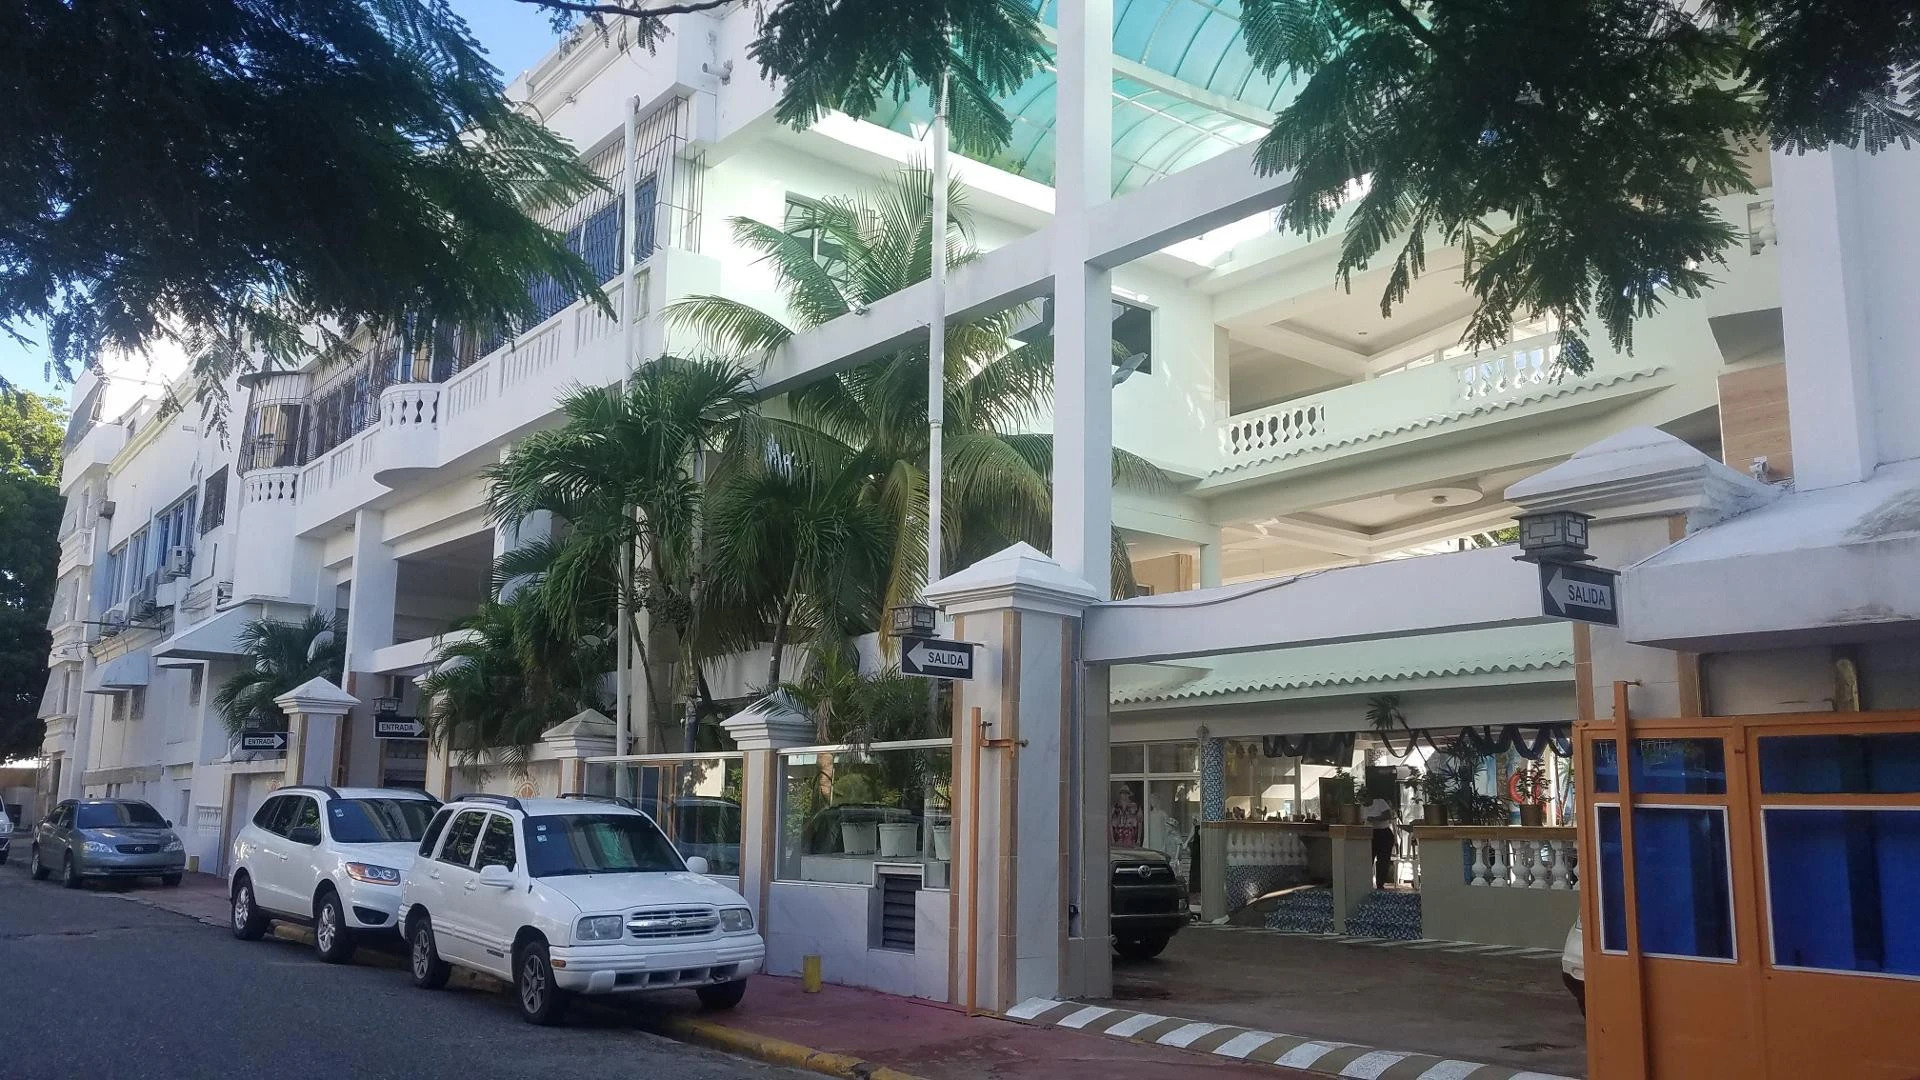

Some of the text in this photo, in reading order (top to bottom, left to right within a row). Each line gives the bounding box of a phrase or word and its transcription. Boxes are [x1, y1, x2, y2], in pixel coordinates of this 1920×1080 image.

[1568, 585, 1606, 606] SALIDA
[928, 652, 964, 666] SALIDA
[381, 723, 414, 731] ENTRADA
